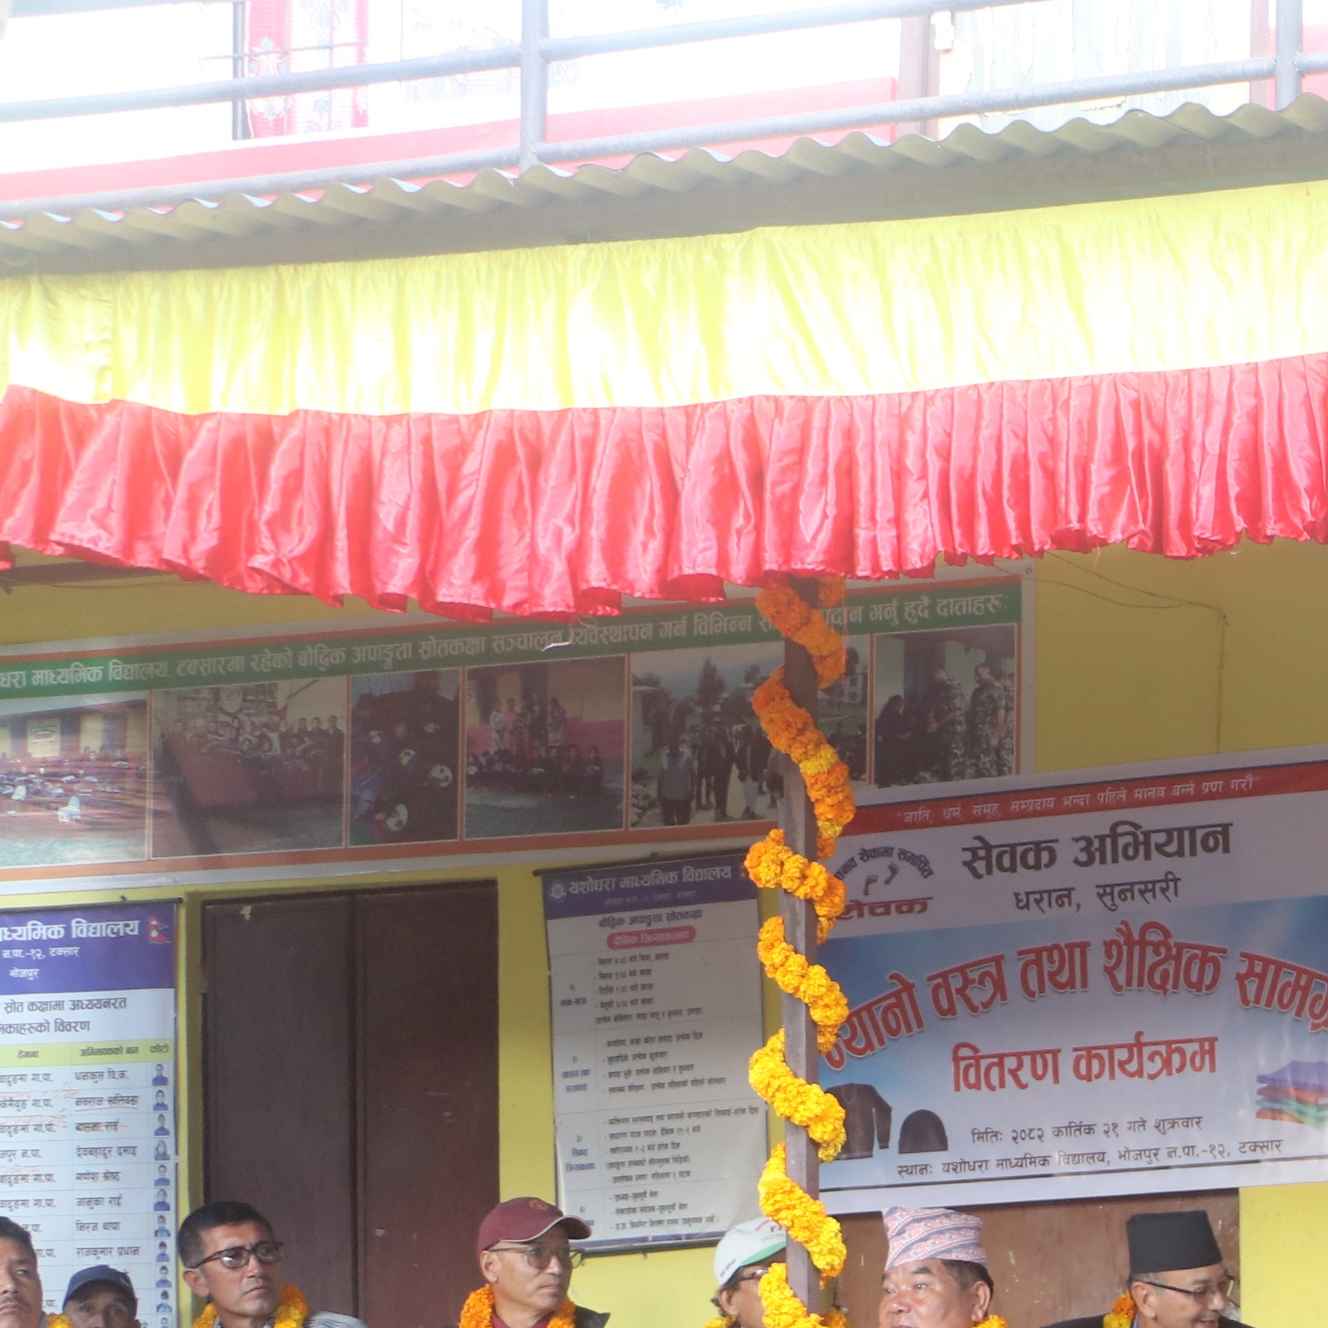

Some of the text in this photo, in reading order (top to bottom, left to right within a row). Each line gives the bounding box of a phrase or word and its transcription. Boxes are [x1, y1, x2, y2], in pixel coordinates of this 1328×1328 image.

[31, 663, 104, 685] माध्यमिक
[108, 659, 168, 682] विद्यालय
[250, 649, 293, 673] रहेको
[961, 819, 1234, 881] सेवक अभियान
[1013, 870, 1182, 915] धरान, सुनसरी
[71, 917, 141, 939] विद्यालय
[926, 952, 1008, 1021] वस्त्र
[1015, 939, 1091, 1001] तथा
[1102, 919, 1229, 999] शैक्षिक
[70, 996, 128, 1012] अध्ययनरत
[54, 1018, 91, 1033] विवरण
[951, 1030, 1219, 1093] वितरण कार्यक्रम
[1010, 1127, 1045, 1144] २०८२
[1051, 1119, 1097, 1138] कार्तिक
[1126, 1119, 1148, 1134] गते
[1153, 1114, 1204, 1135] शुक्रवार
[941, 1157, 990, 1175] यशोधरा
[995, 1153, 1052, 1171] माध्यमिक
[1117, 1146, 1161, 1166] भोजपुर
[1237, 1138, 1285, 1156] टक्सार
